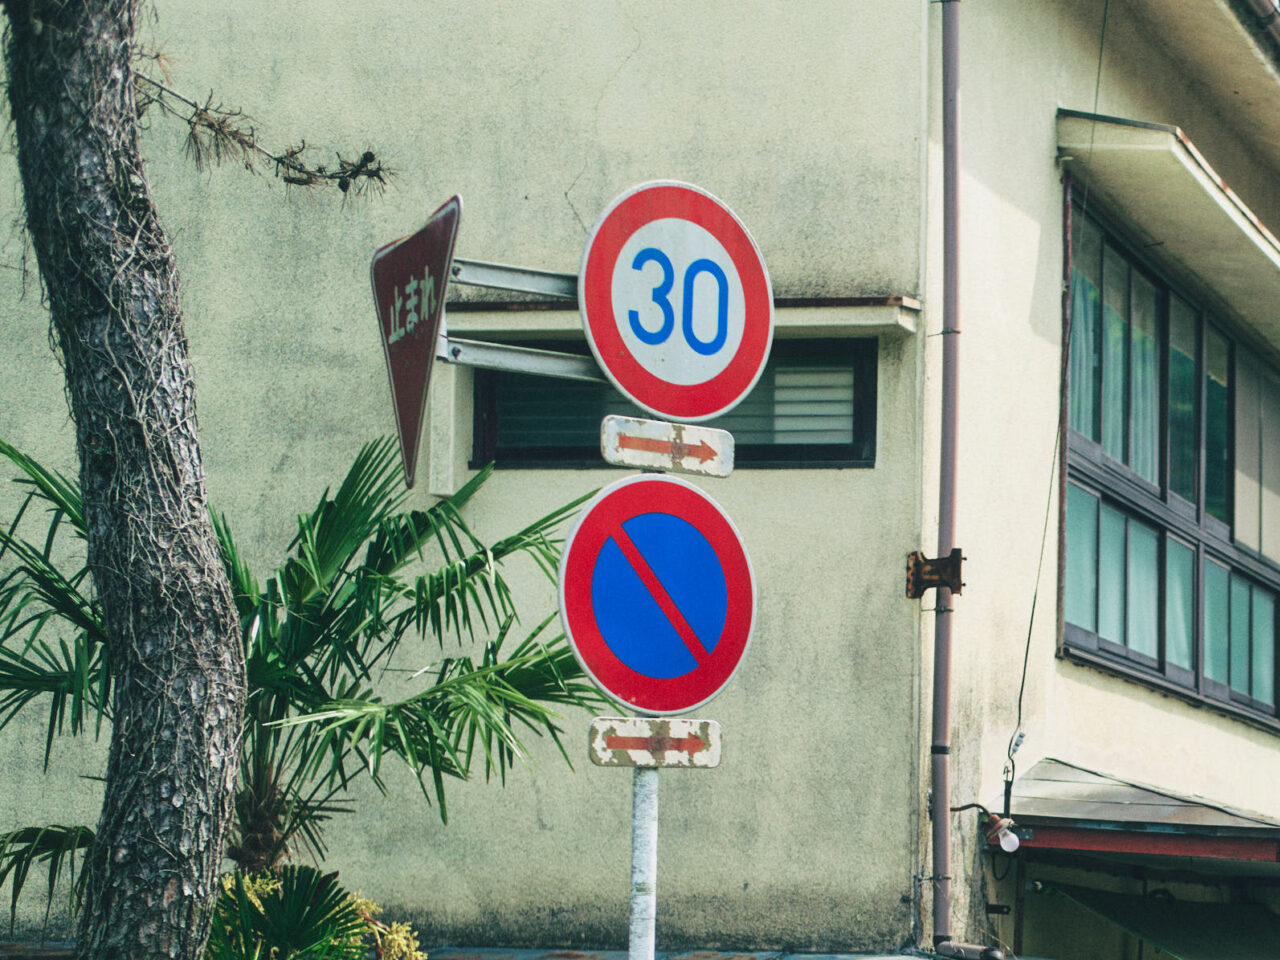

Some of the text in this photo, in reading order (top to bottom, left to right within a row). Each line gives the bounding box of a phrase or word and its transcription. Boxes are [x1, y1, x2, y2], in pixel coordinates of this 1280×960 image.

[388, 265, 436, 345] 止まれ
[628, 248, 729, 356] 30
